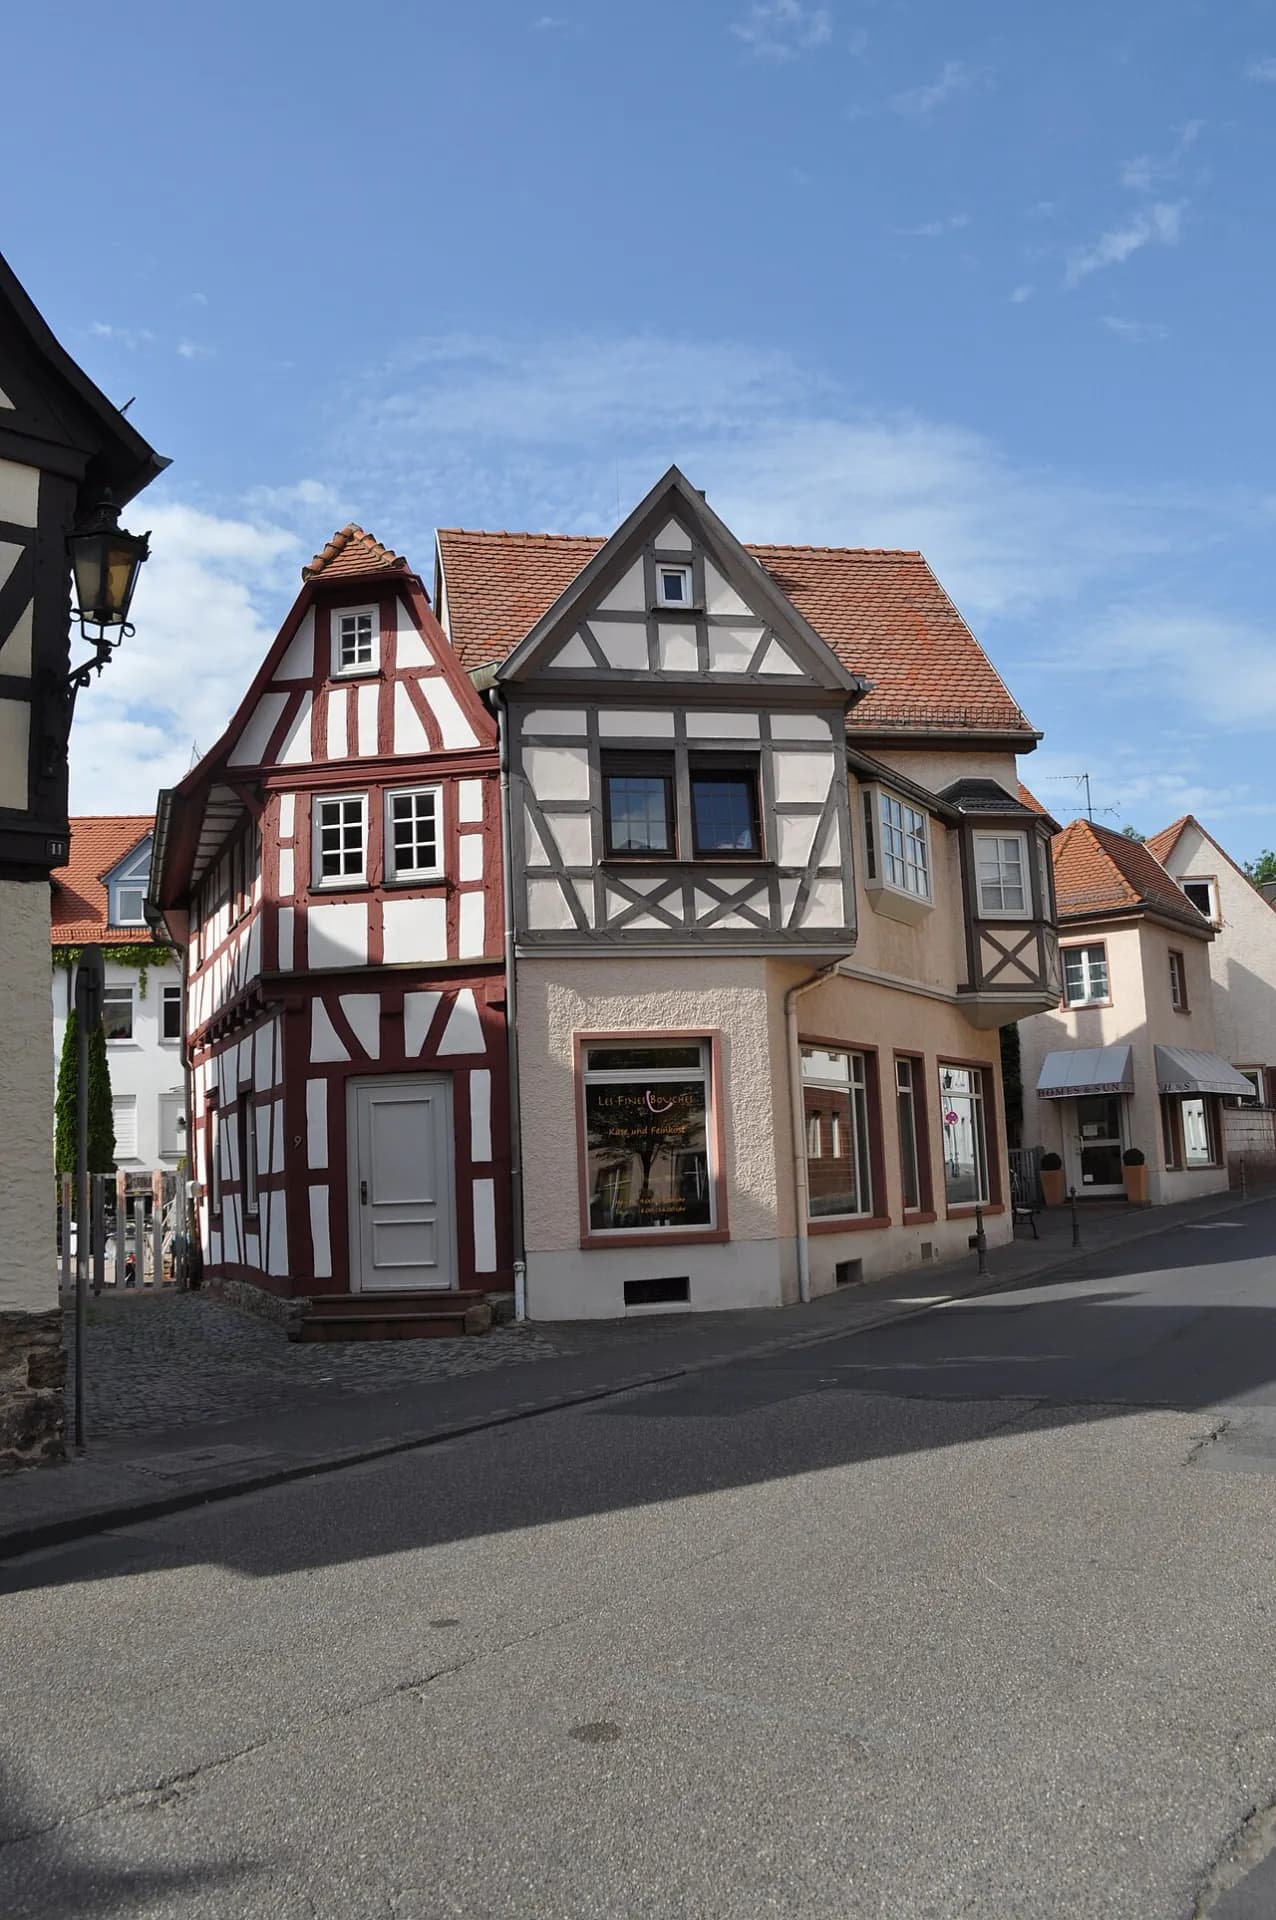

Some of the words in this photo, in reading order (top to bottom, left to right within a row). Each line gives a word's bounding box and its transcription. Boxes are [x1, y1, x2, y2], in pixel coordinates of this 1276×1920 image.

[51, 843, 62, 855] 11
[1038, 1087, 1080, 1097] HOMES
[1095, 1083, 1120, 1092] SUN
[631, 1126, 647, 1135] und
[651, 1126, 686, 1135] Feinkost
[294, 1135, 302, 1149] 9
